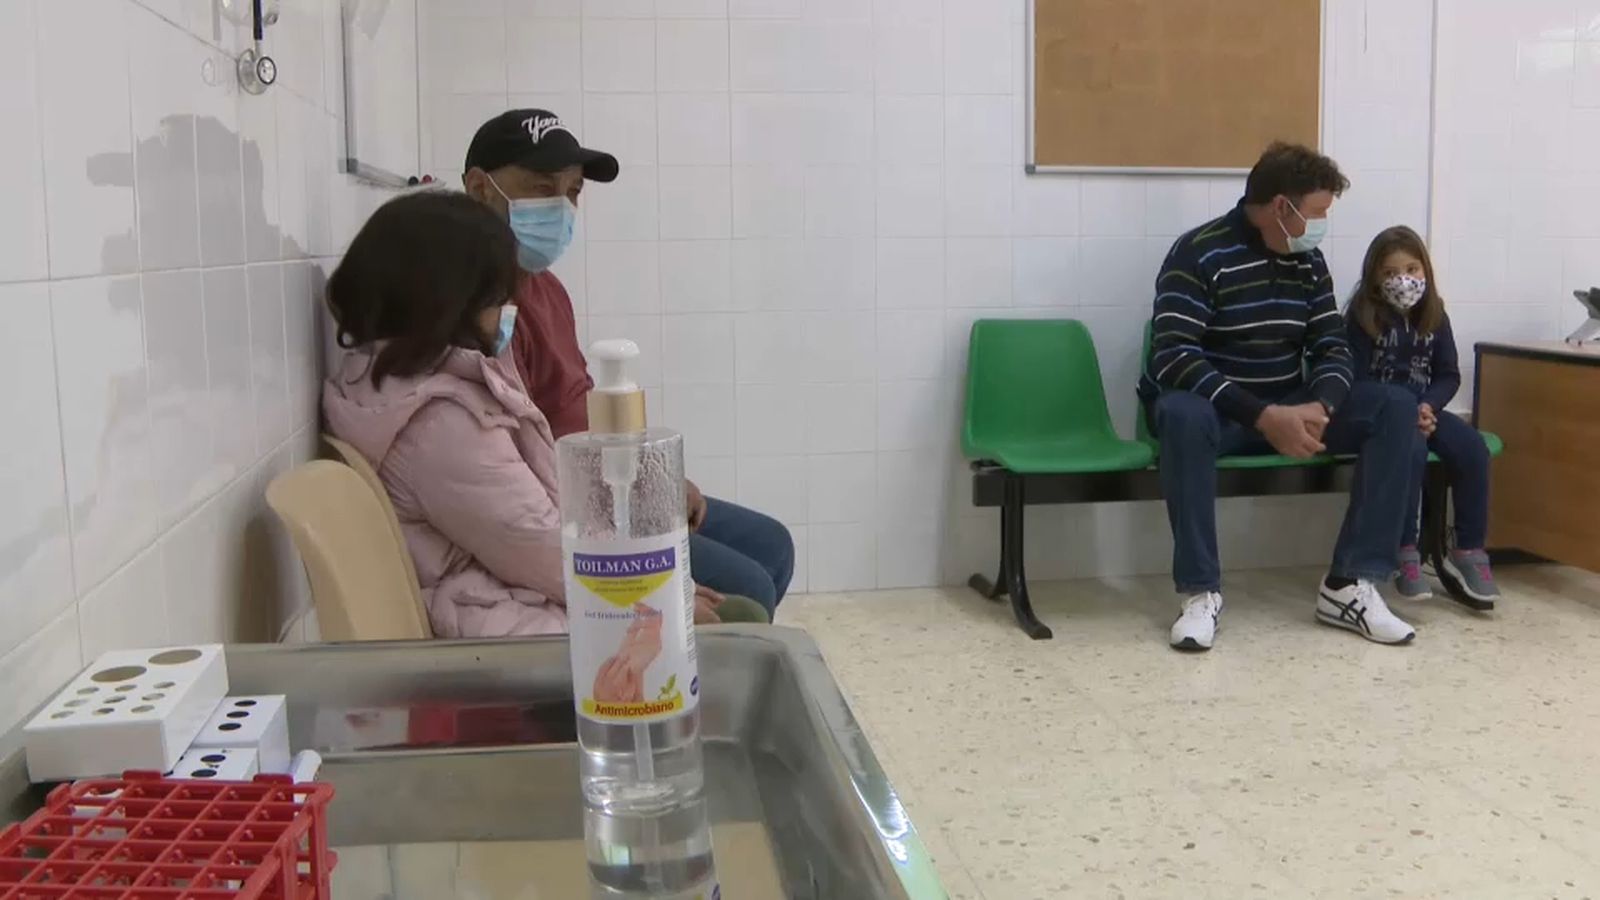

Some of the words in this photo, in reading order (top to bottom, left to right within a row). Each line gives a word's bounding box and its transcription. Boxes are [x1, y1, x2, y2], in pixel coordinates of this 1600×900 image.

[575, 559, 641, 574] TOILMAN
[644, 556, 672, 570] G.A.
[594, 701, 675, 717] Antimicrobiano
